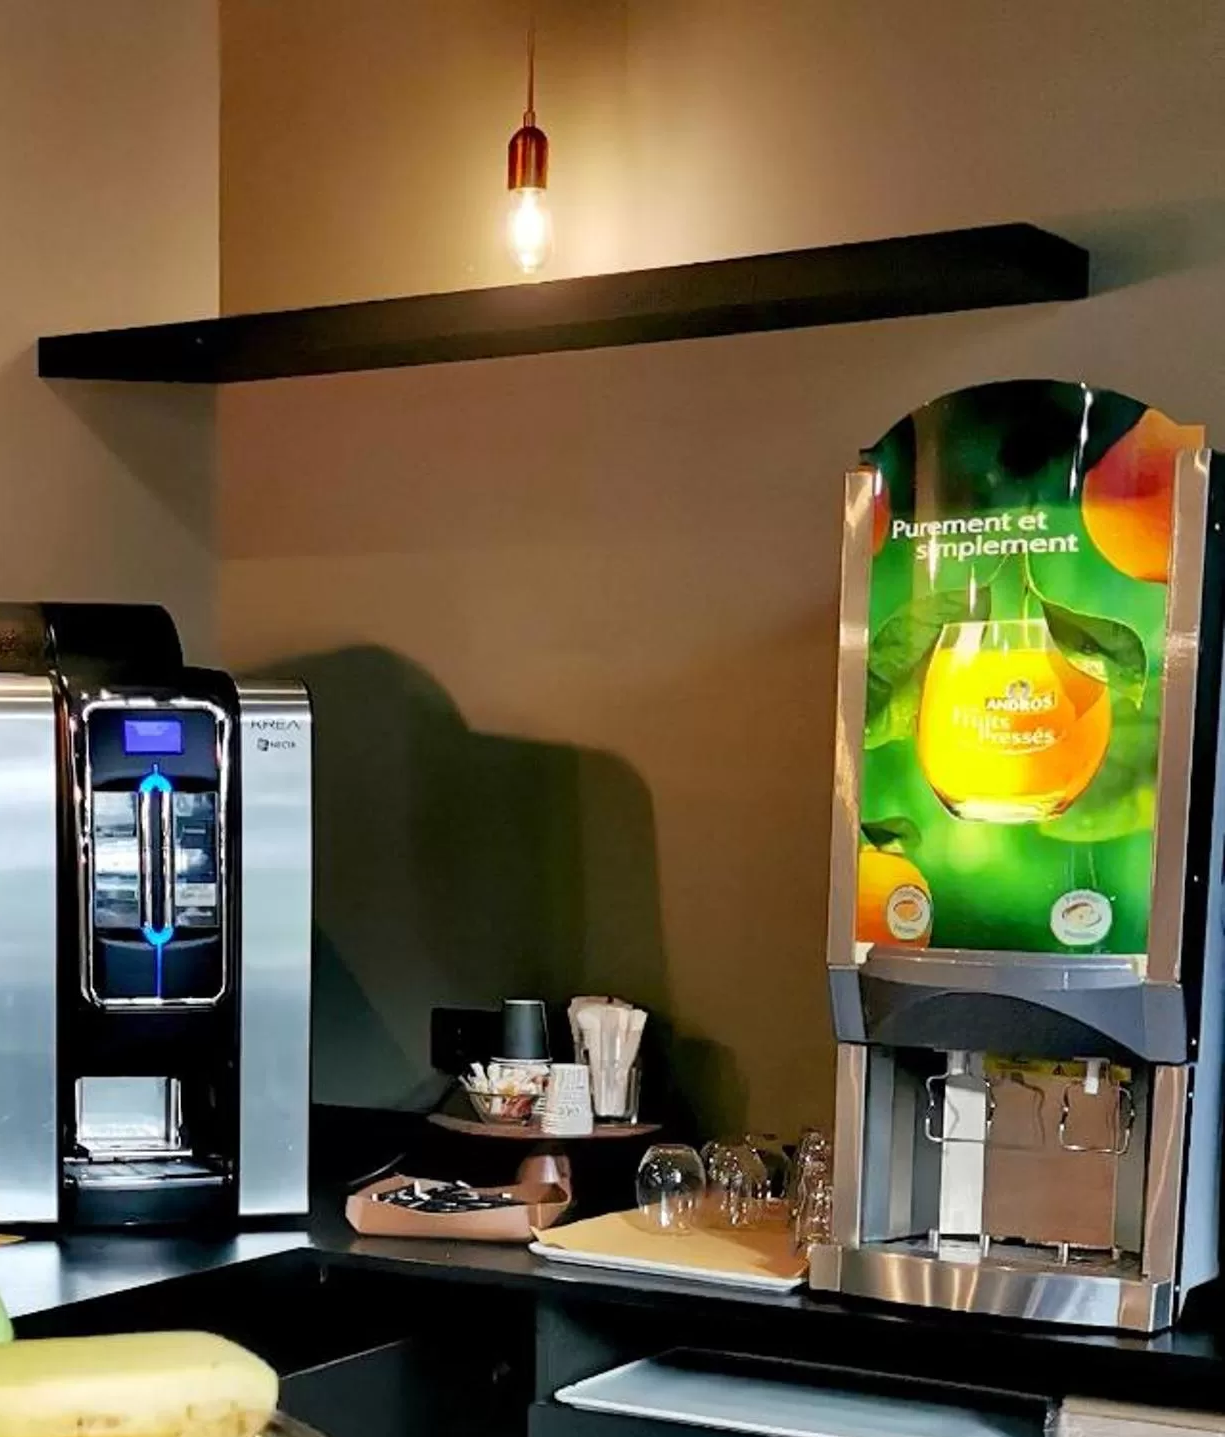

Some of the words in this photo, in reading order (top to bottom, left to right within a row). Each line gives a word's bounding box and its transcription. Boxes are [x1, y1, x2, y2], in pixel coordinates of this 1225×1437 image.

[891, 512, 1012, 539] Purement
[1018, 511, 1048, 531] et
[916, 533, 1079, 562] simplement
[986, 692, 1054, 712] ANDROS
